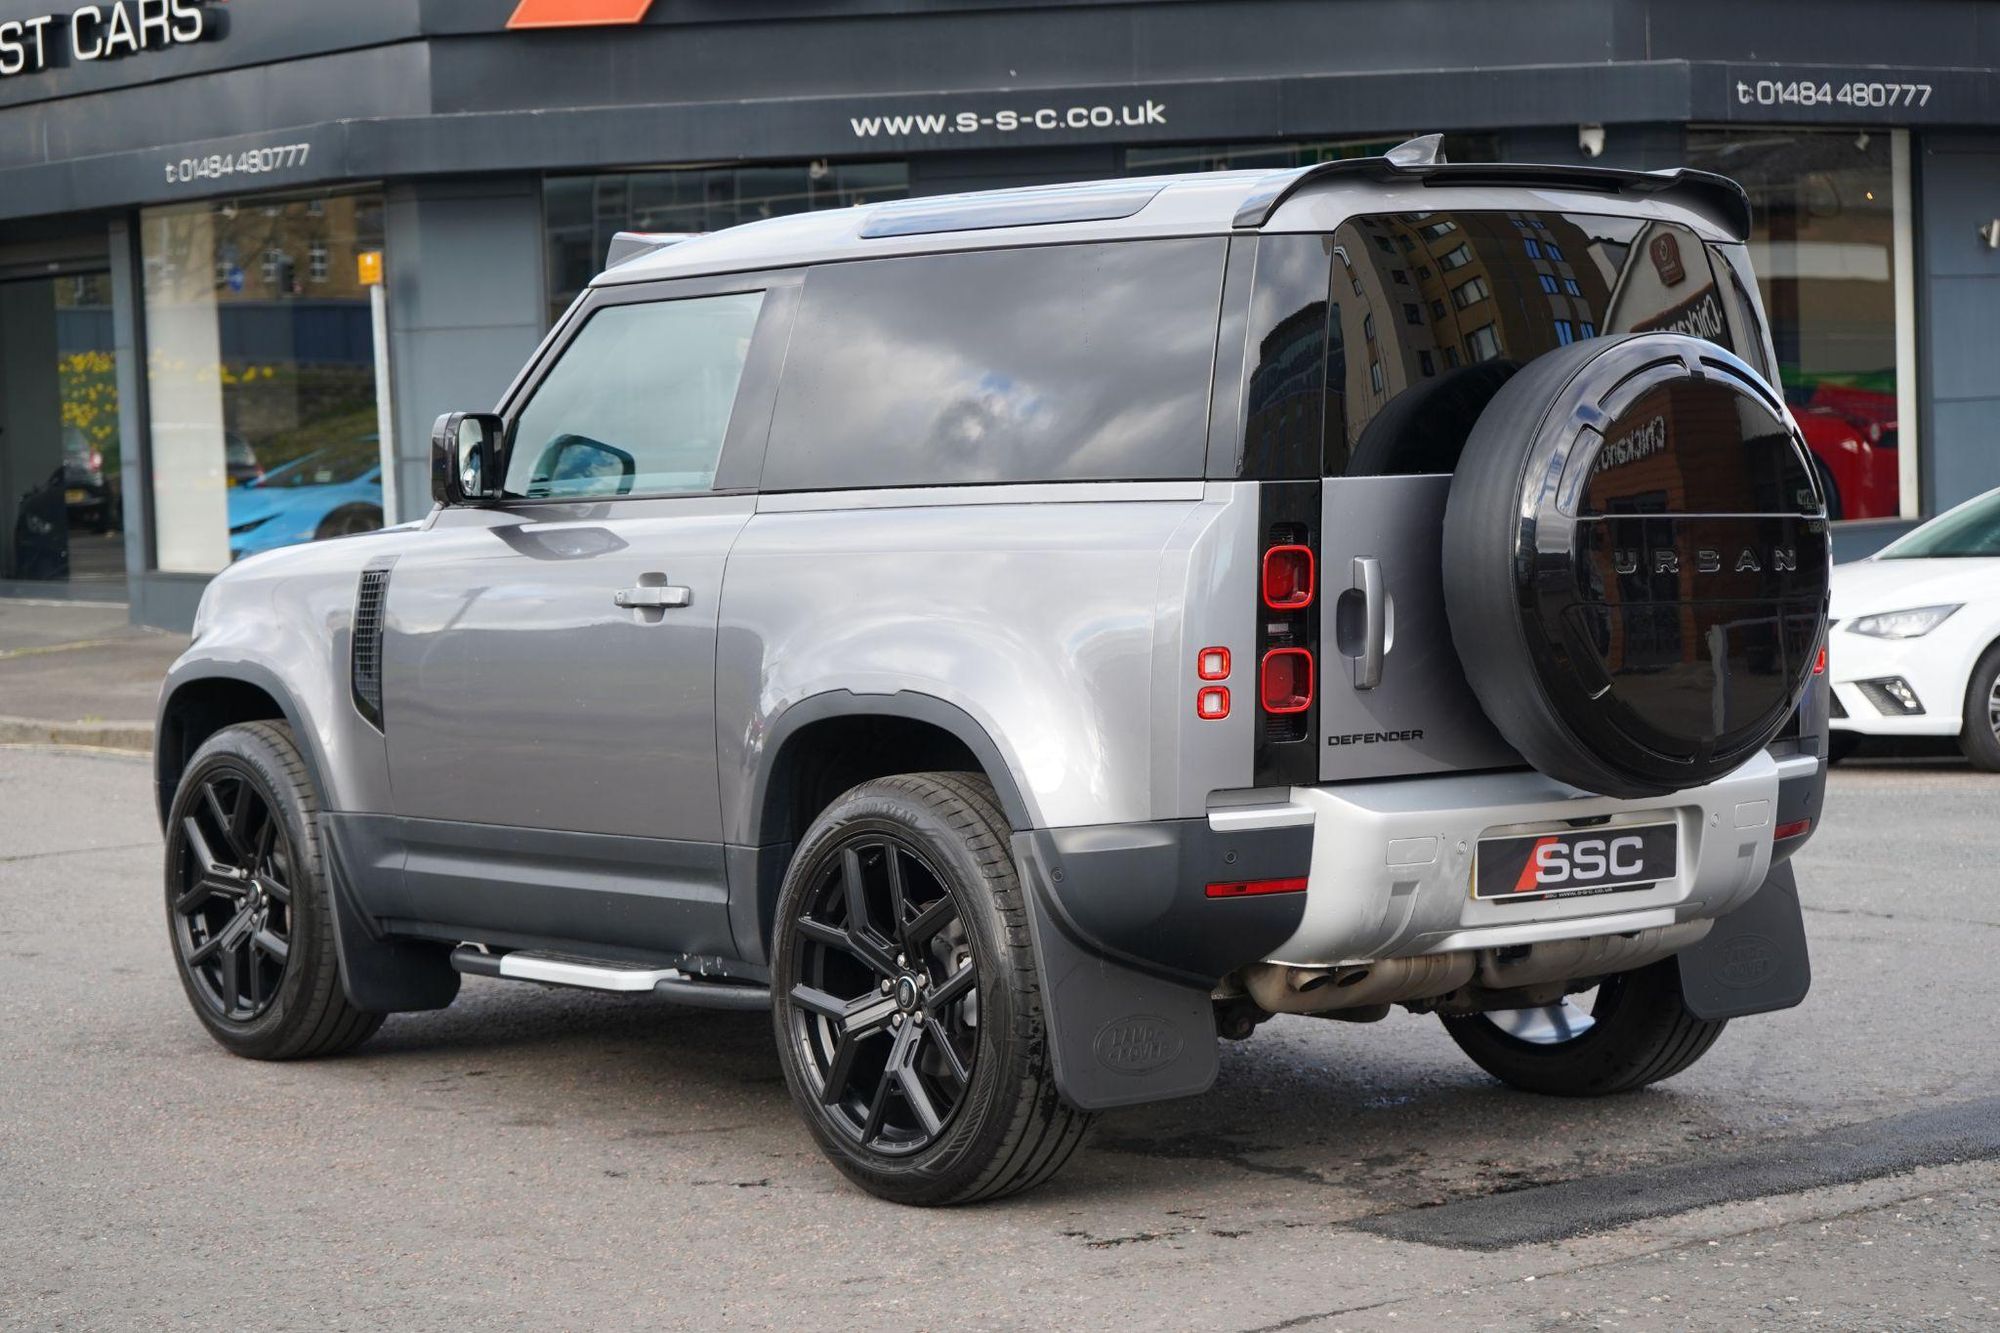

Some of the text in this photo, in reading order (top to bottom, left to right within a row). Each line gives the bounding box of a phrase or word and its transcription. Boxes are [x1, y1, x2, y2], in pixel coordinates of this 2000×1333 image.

[71, 0, 203, 61] CARS
[1736, 80, 1932, 107] t:01484 480777
[851, 100, 1167, 137] www.s-s-c.co.uk
[235, 143, 310, 173] 480777
[1614, 549, 1797, 574] URBAN
[1327, 729, 1424, 746] DEFENDER
[1535, 836, 1644, 884] SSC
